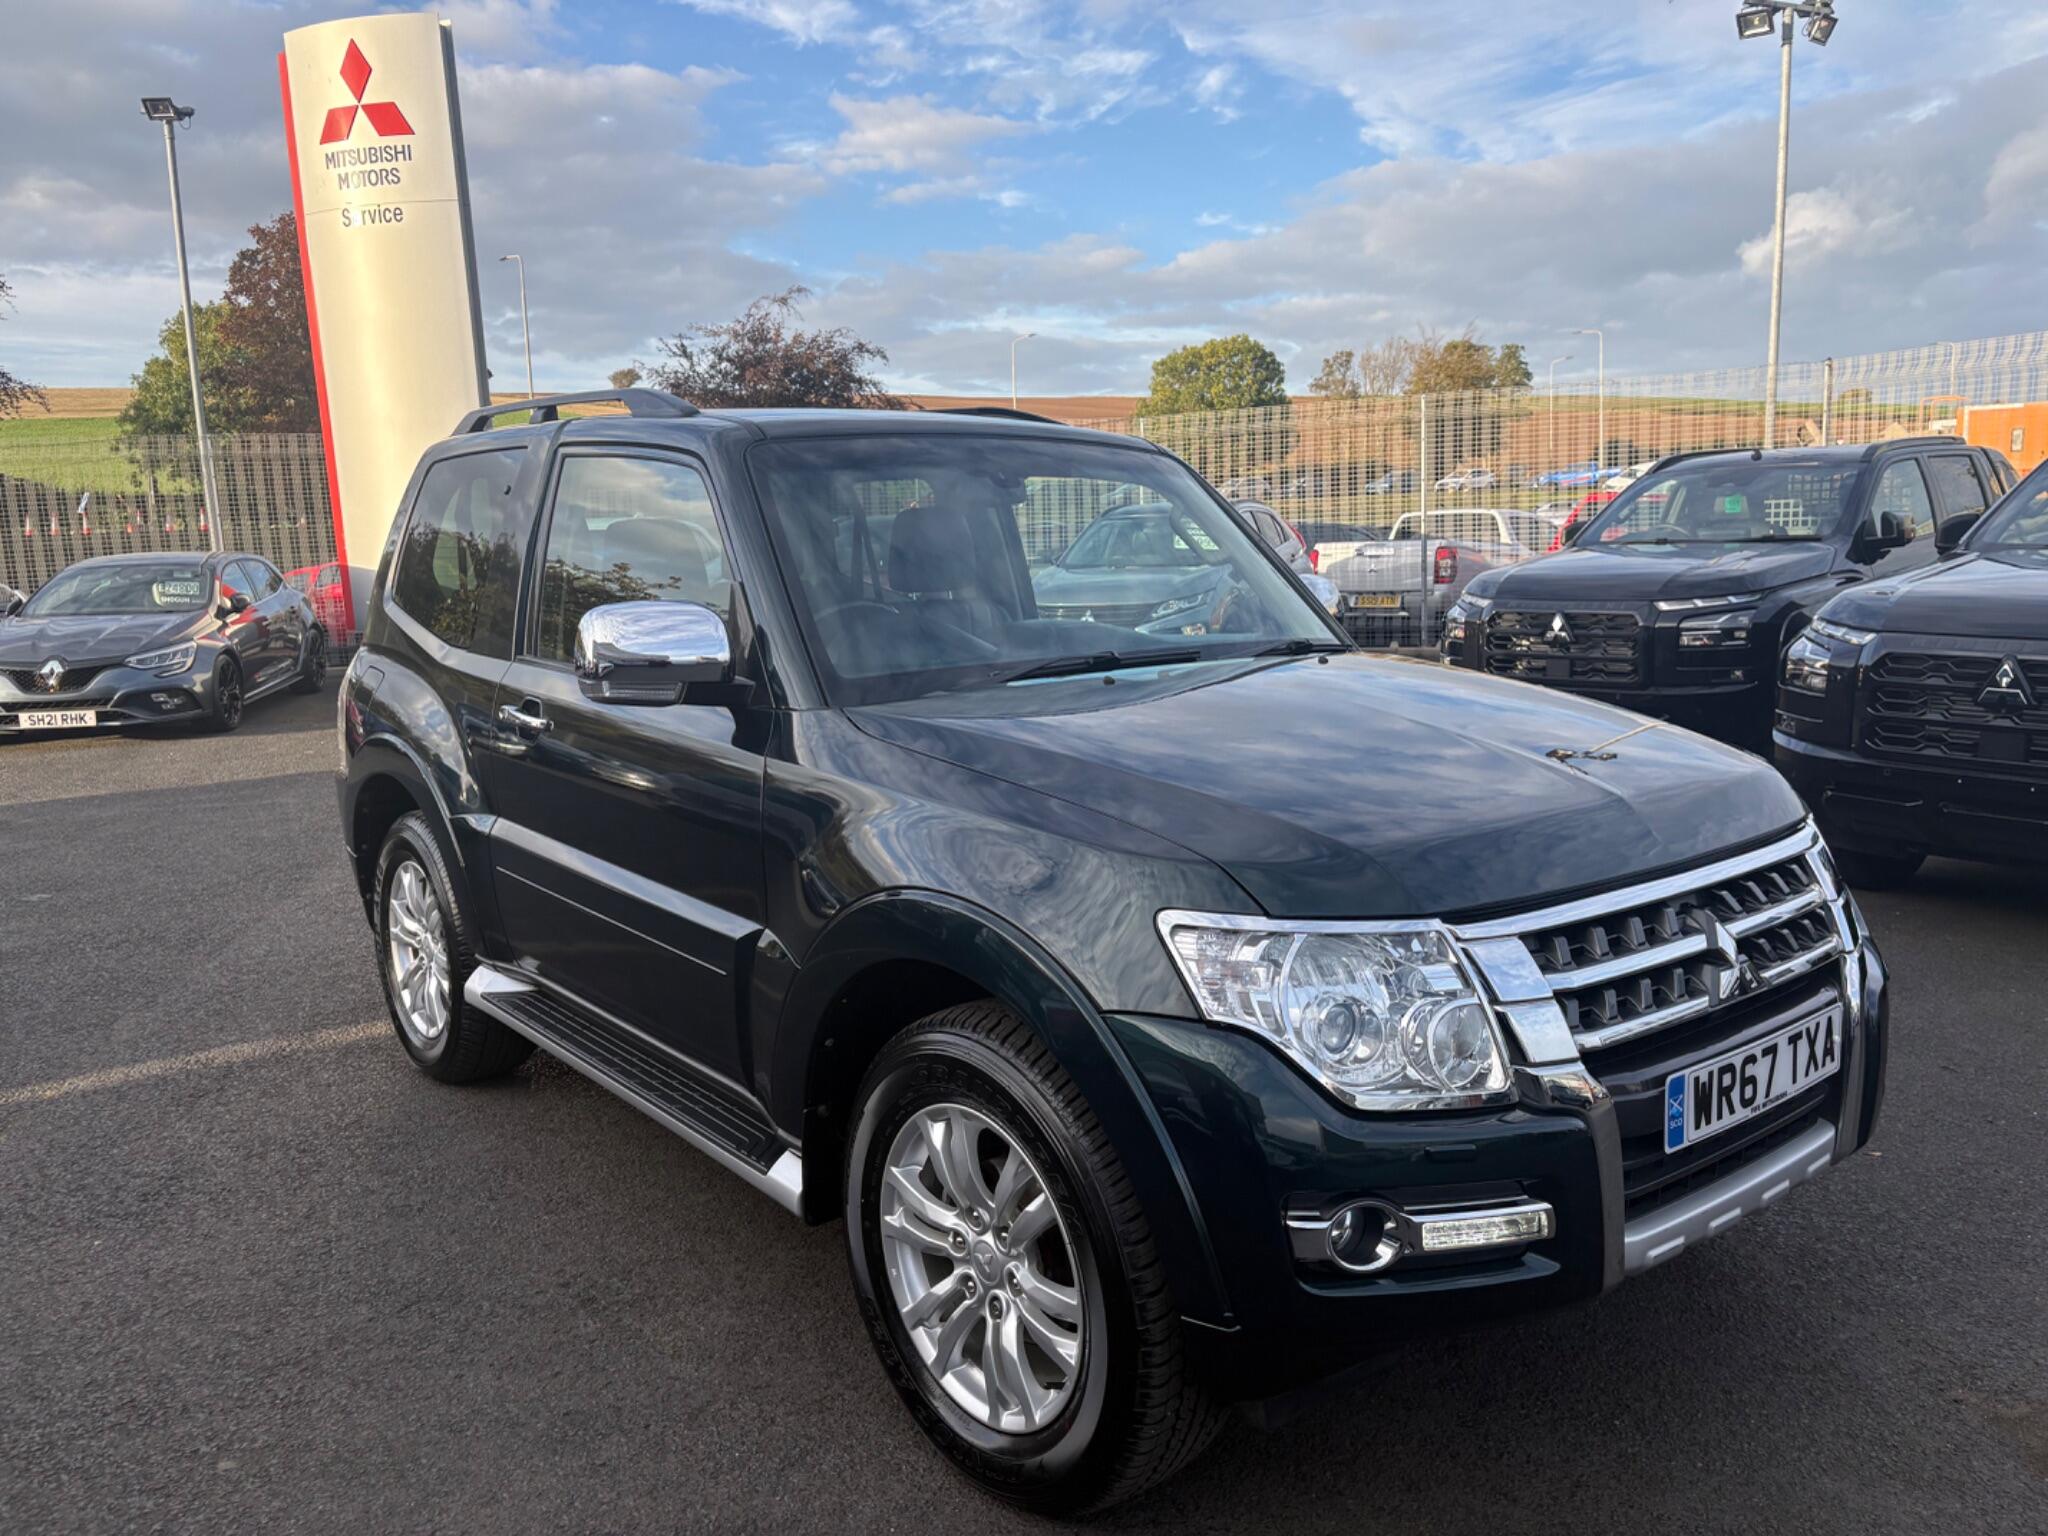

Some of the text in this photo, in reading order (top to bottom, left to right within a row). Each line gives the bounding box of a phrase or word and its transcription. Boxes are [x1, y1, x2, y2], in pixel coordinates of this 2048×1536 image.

[325, 144, 412, 169] MITSUBISHI
[338, 167, 401, 190] MOTORS
[342, 205, 404, 227] Srvice
[28, 713, 88, 726] SH21 RHK
[1694, 1015, 1836, 1132] WR67 TXA
